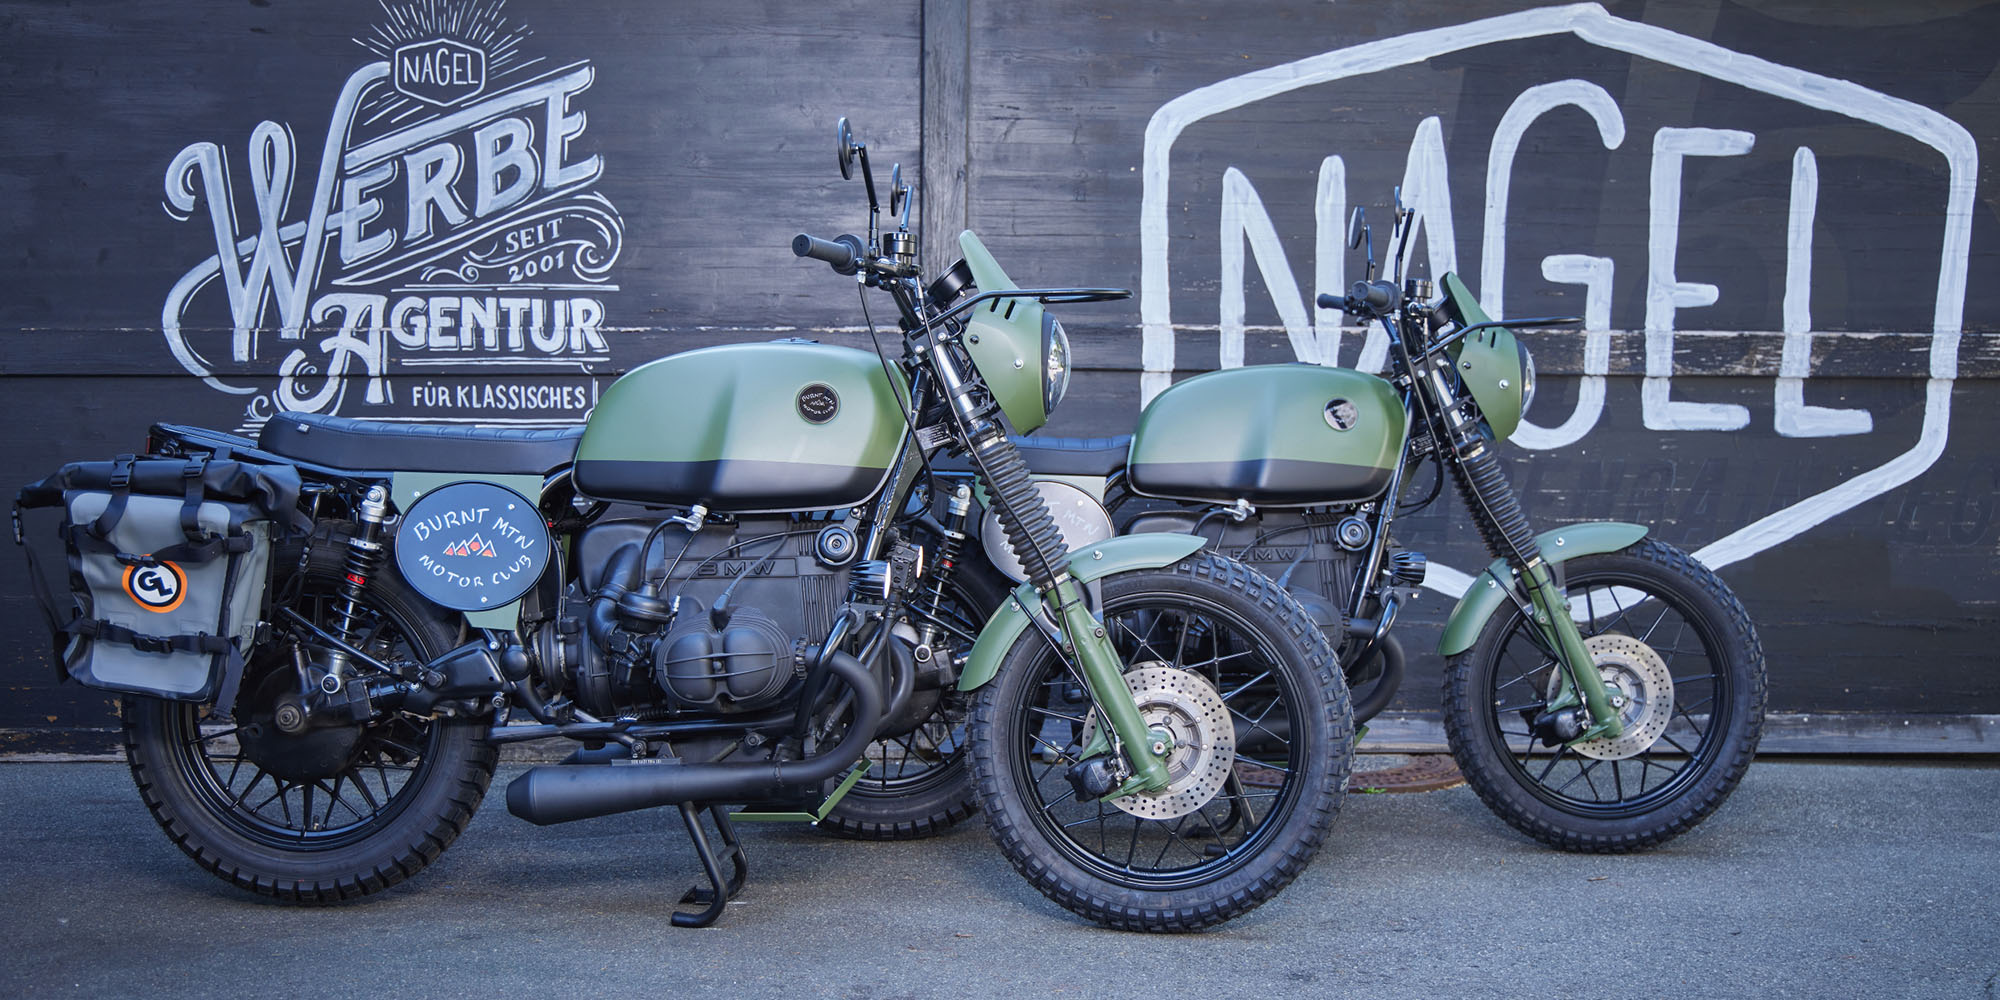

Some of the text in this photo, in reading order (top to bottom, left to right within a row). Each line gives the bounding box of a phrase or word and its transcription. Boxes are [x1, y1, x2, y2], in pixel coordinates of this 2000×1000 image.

[403, 47, 479, 86] NAGEL
[161, 60, 603, 393] WERBE
[505, 217, 563, 254] SEIT
[508, 251, 567, 283] 2001
[1218, 78, 1874, 452] NAGEL
[277, 293, 609, 412] AGENTUR
[412, 384, 587, 410] FÜR KLASSISCHES
[413, 508, 535, 550] BURNT MTN
[137, 570, 174, 597] GL
[418, 554, 532, 588] MOTOR CLUB
[697, 561, 776, 576] BMW
